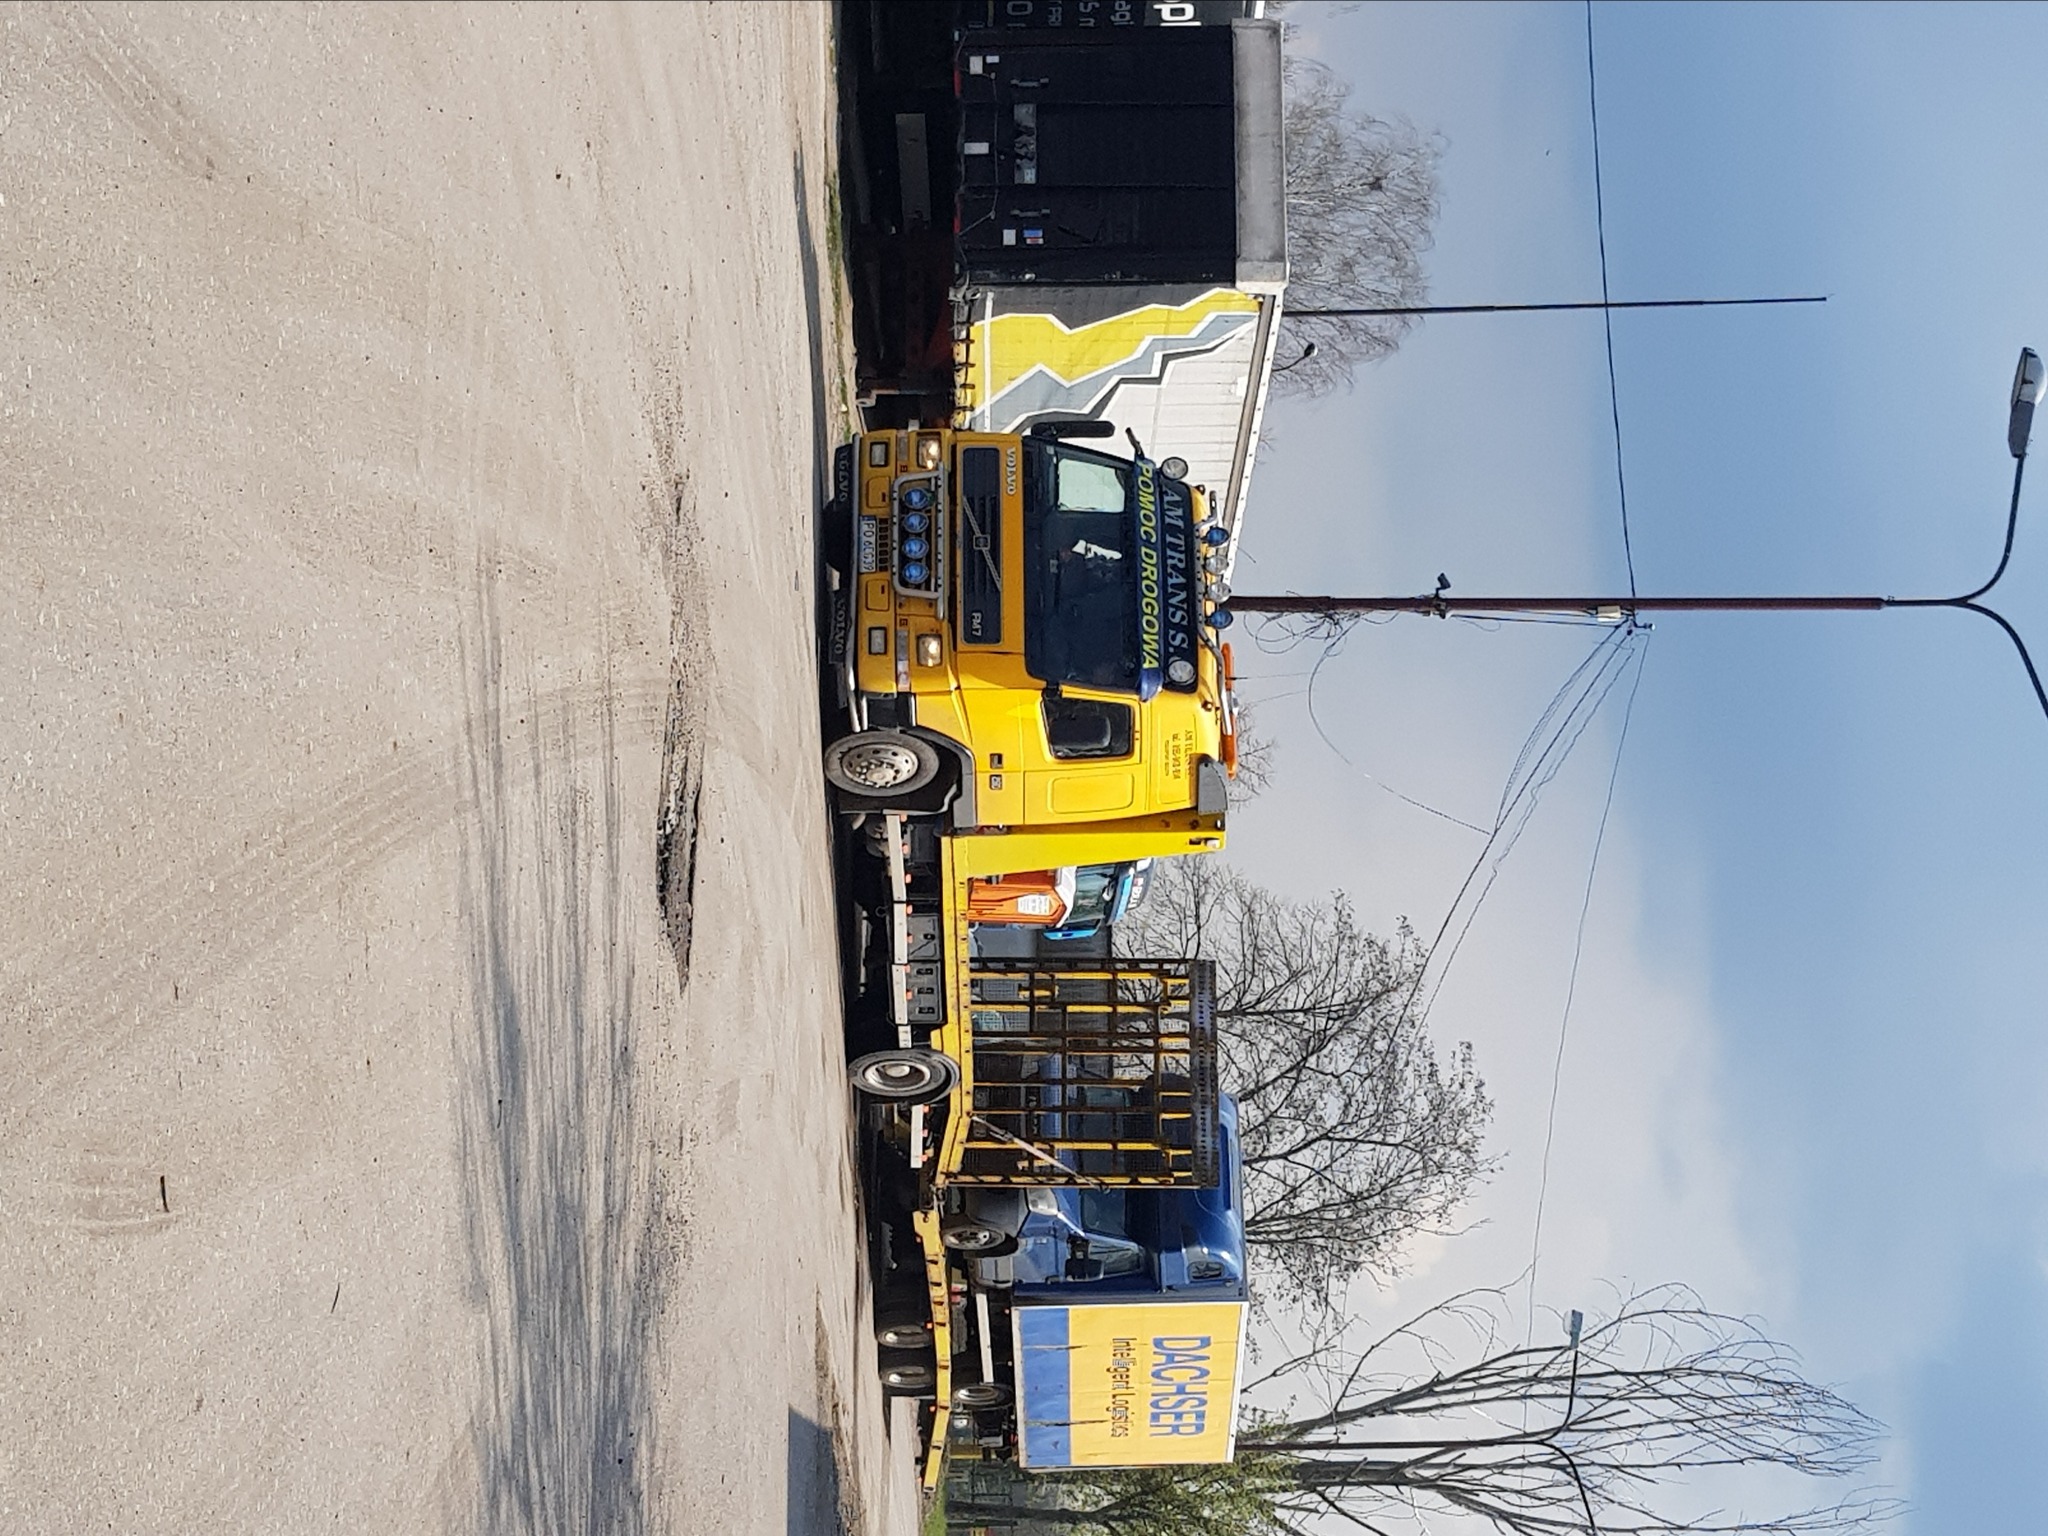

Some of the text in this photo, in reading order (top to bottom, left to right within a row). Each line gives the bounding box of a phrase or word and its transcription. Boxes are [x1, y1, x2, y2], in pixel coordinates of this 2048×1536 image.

[1152, 0, 1201, 26] pl
[1005, 447, 1016, 496] VOLVO
[1161, 486, 1184, 530] AM
[1135, 461, 1159, 669] POMOC DROGOWA
[1163, 532, 1187, 625] TRANS
[833, 599, 845, 655] VOLVO
[969, 612, 981, 637] FM7
[1105, 1337, 1137, 1438] Intelligent Logistics
[1149, 1336, 1211, 1437] DACHSER
